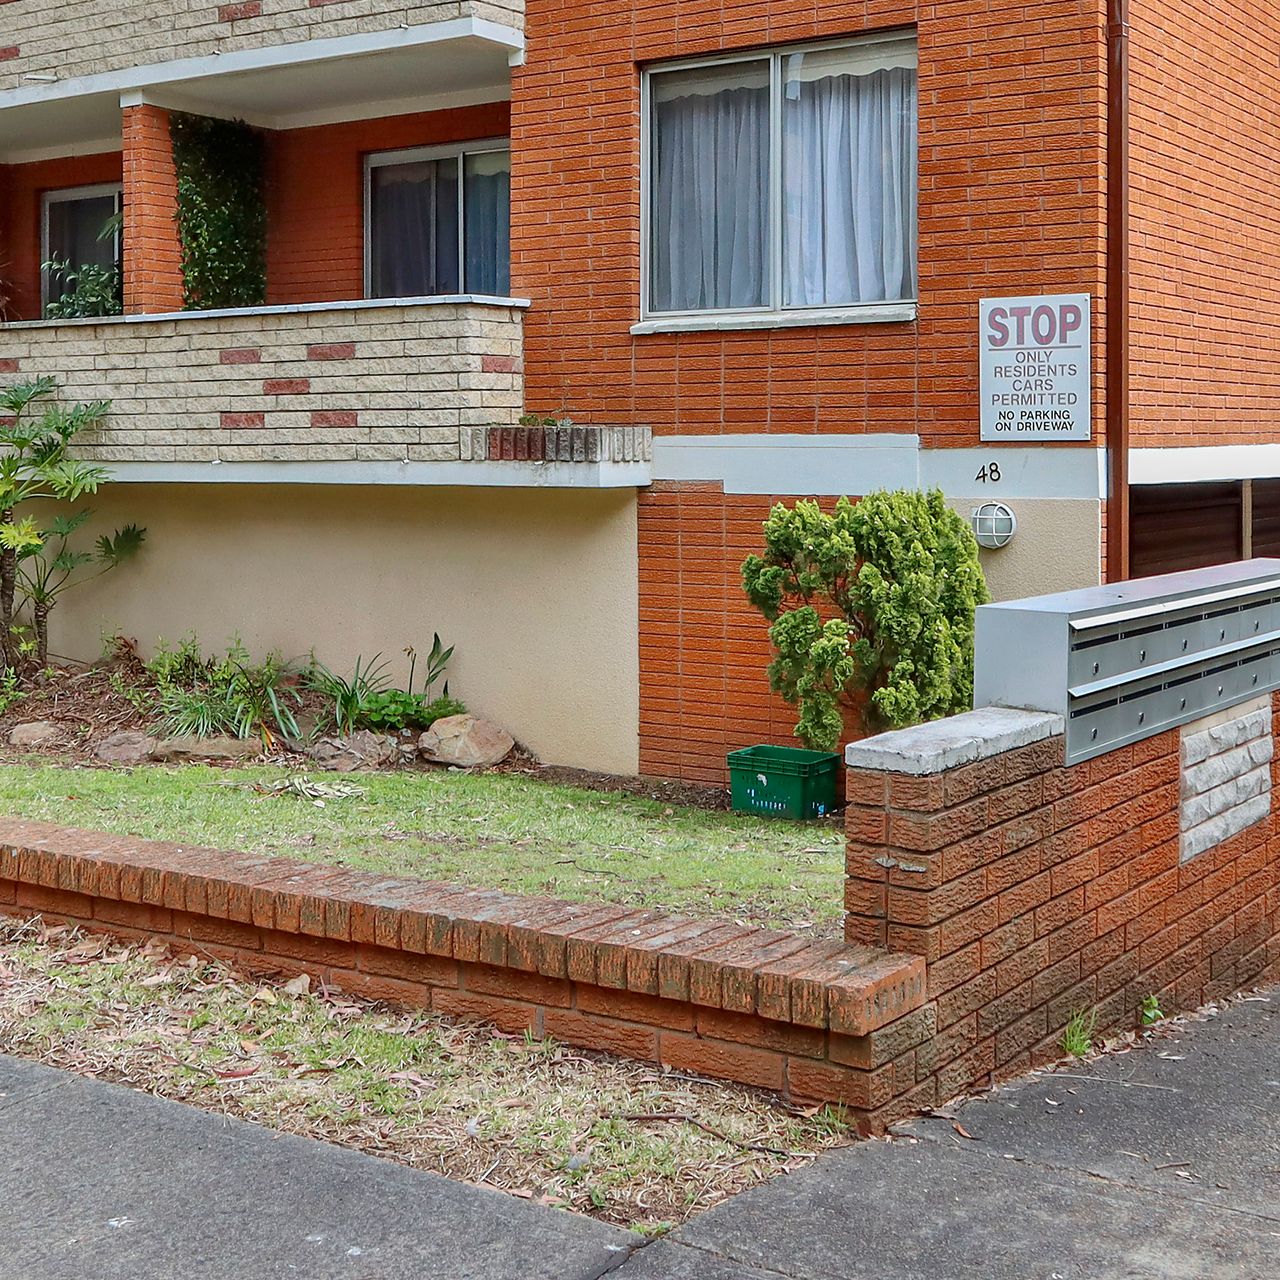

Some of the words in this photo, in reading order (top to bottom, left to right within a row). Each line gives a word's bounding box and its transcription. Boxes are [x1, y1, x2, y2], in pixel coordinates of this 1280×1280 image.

[987, 305, 1082, 347] STOP
[1015, 350, 1053, 363] ONLY
[994, 364, 1077, 378] RESIDENTS
[1012, 379, 1054, 391] CARS
[991, 393, 1078, 406] PERMITTED
[998, 411, 1015, 420] NO
[1020, 410, 1071, 420] PARKING
[995, 422, 1012, 431] ON
[1017, 421, 1075, 431] DRIVEWAY
[975, 462, 1001, 484] 48
